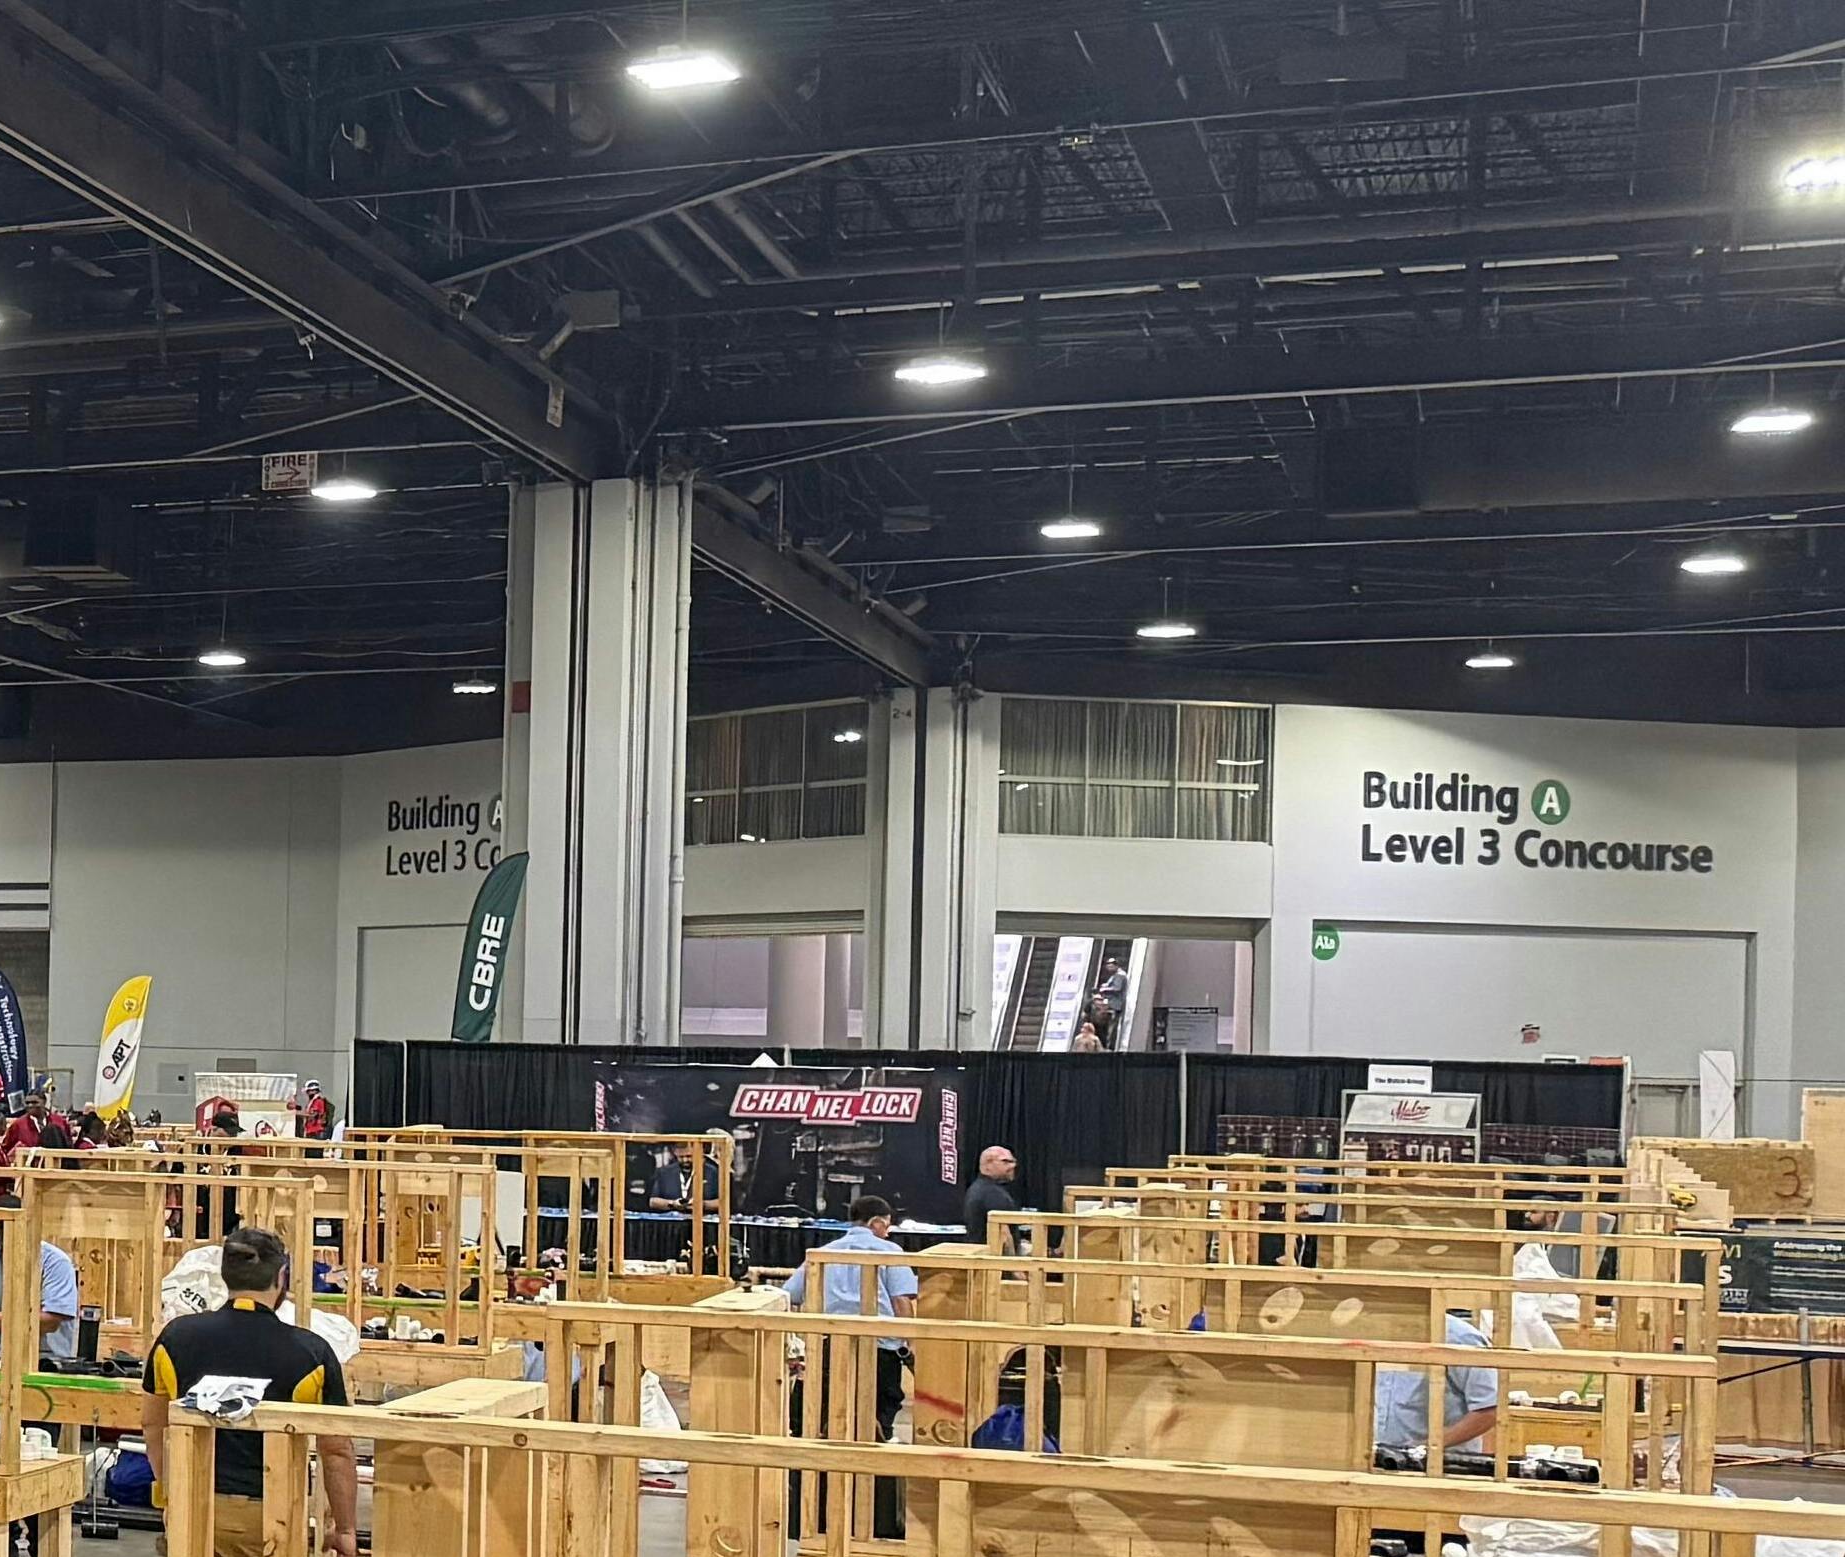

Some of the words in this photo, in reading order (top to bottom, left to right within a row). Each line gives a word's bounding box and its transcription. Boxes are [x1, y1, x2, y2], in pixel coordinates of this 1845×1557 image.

[272, 454, 307, 468] FIRE
[387, 798, 481, 837] Building
[1363, 772, 1519, 825] Building
[1539, 787, 1563, 816] A
[386, 842, 449, 876] Level
[454, 840, 468, 871] 3
[1362, 824, 1465, 864] Level
[1478, 829, 1501, 866] 3
[1515, 829, 1714, 874] Concourse
[469, 914, 505, 1011] CBRE
[110, 1039, 132, 1068] APT
